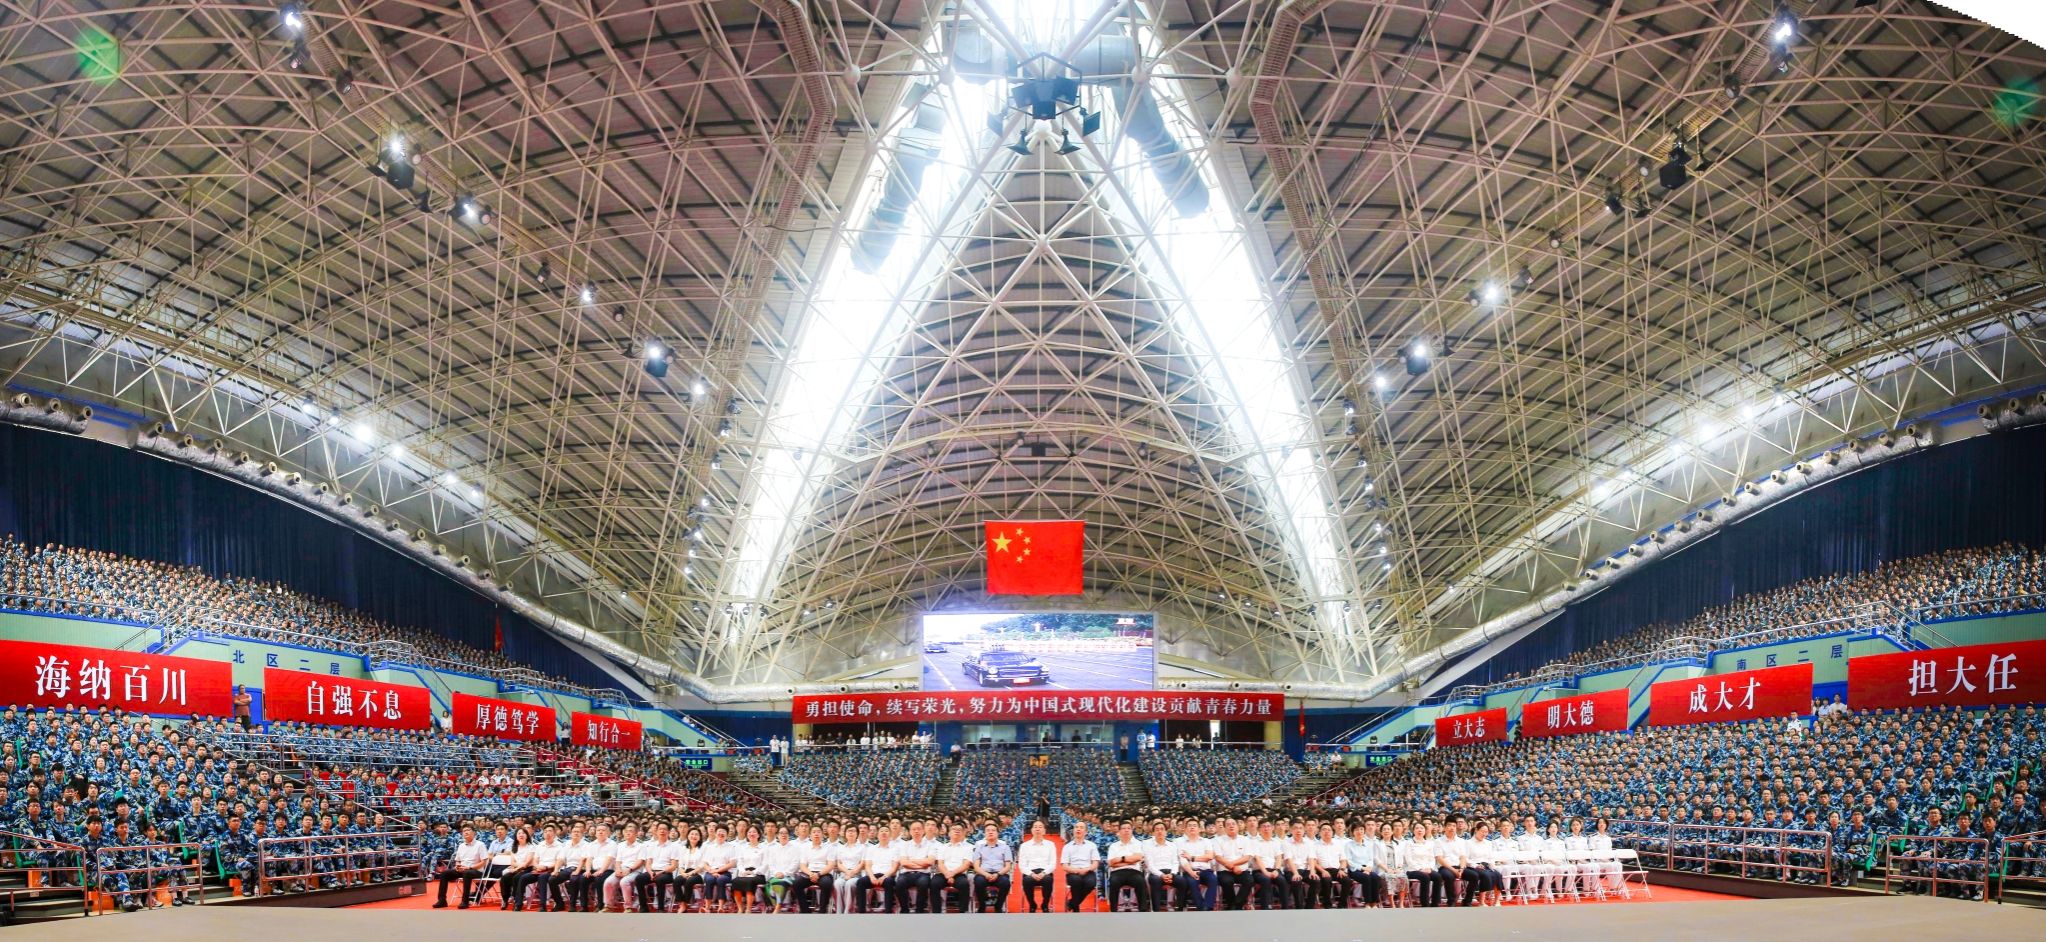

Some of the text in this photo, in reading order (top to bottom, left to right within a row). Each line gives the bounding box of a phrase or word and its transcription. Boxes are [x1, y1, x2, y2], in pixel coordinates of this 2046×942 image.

[233, 649, 341, 676] 北区二层
[1736, 644, 1843, 671] 南区二层
[35, 655, 187, 706] 海纳百川
[1908, 653, 2019, 697] 担大任
[306, 680, 402, 720] 自强不息
[1688, 676, 1761, 714] 成大才
[476, 703, 540, 735] 厚德笃学
[1452, 716, 1486, 739] 立大志
[1547, 700, 1594, 729] 明大德
[587, 719, 631, 744] 知行合一
